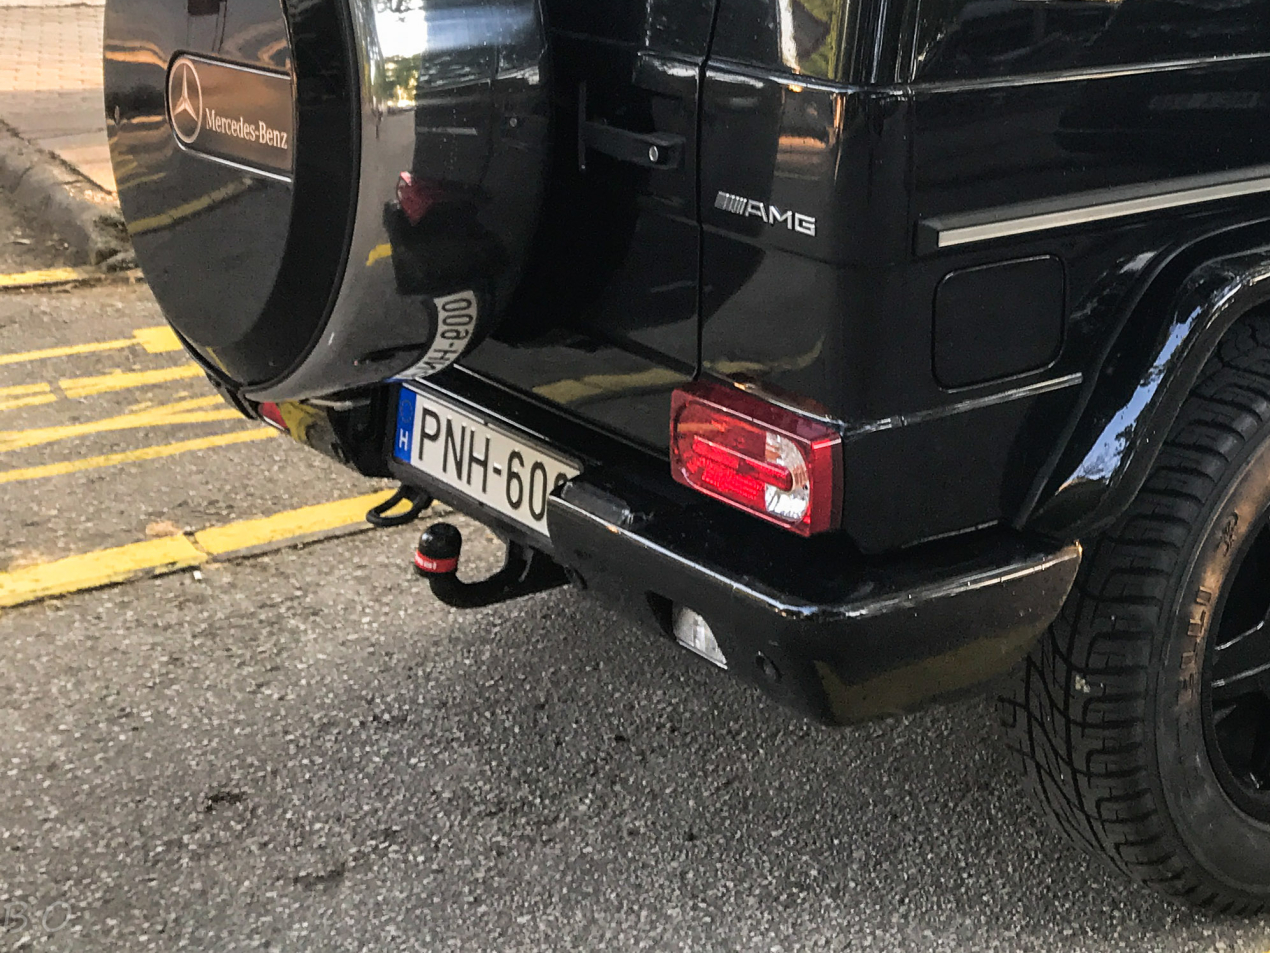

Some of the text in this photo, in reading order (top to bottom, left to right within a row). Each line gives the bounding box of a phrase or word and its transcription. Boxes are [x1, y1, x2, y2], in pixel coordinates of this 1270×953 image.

[205, 108, 288, 149] Mercedes-Benz
[745, 198, 816, 237] AMG
[398, 428, 409, 452] H
[417, 406, 568, 522] PNH-60
